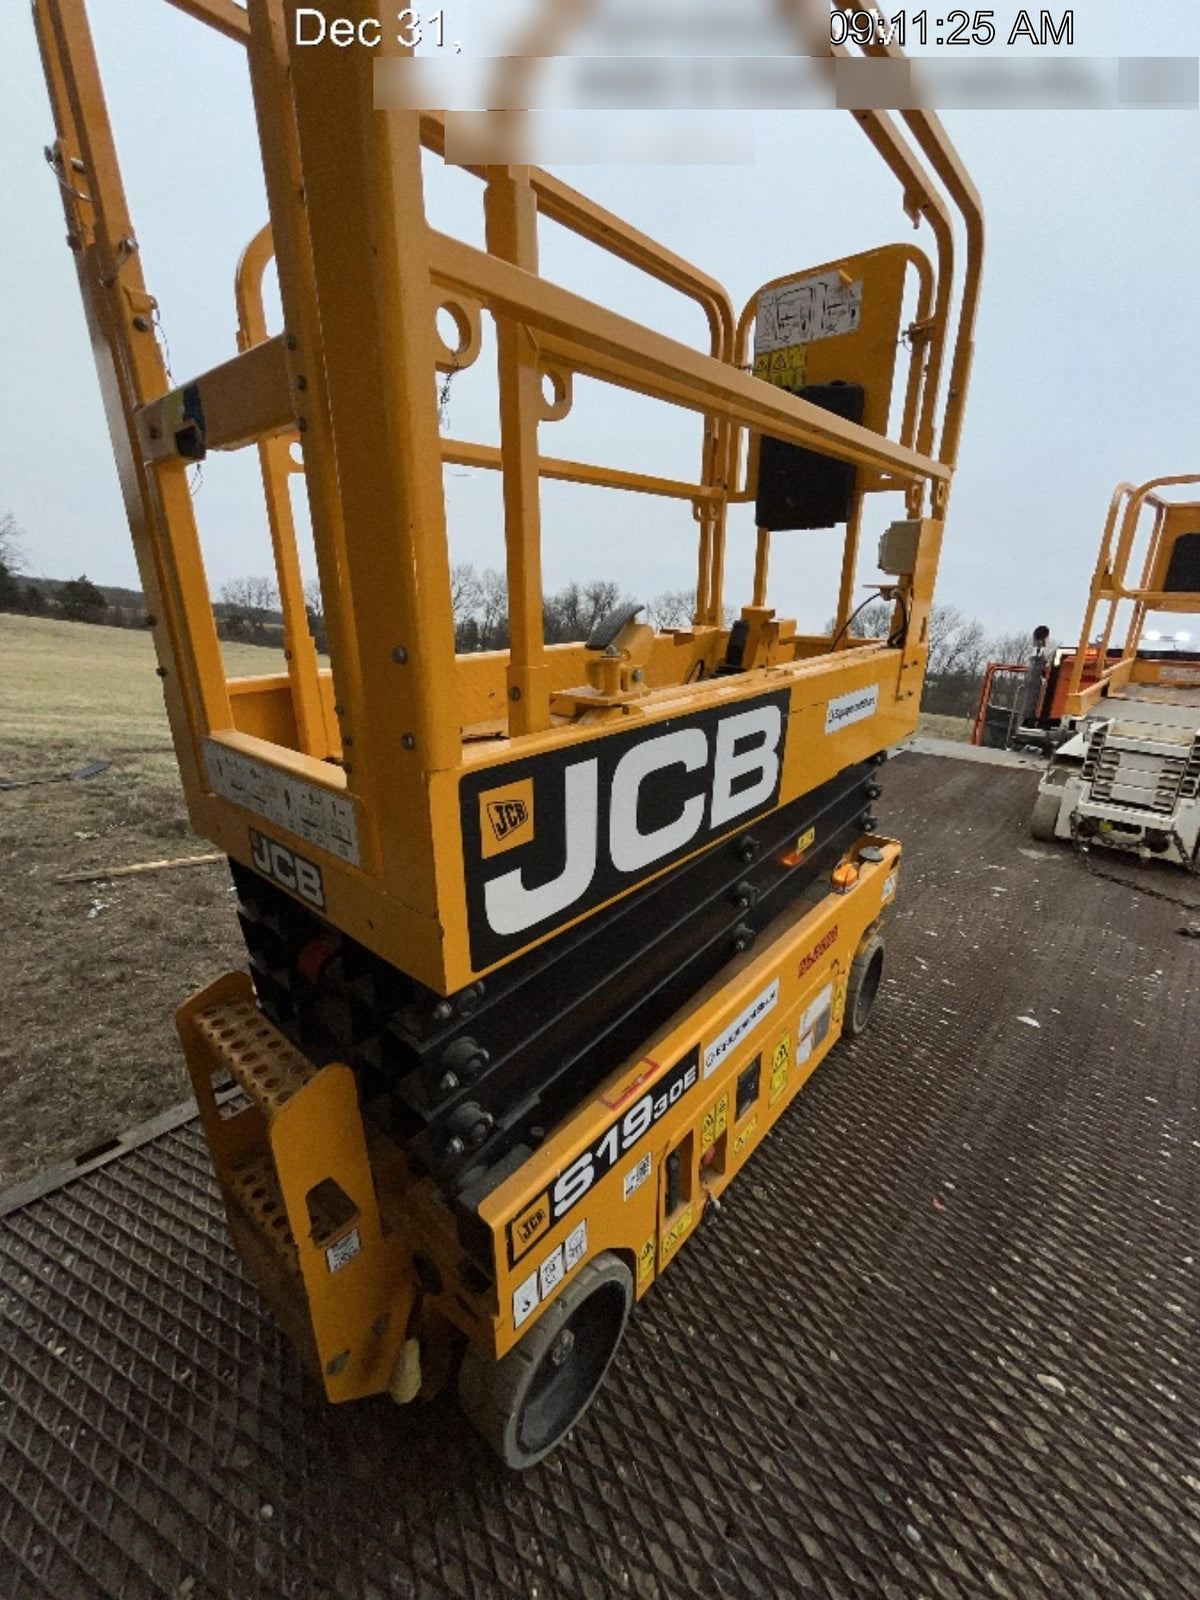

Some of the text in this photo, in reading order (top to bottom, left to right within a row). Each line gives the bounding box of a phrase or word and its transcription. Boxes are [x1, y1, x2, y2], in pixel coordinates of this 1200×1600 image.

[483, 704, 782, 936] JCB
[491, 801, 527, 838] JCB
[253, 836, 325, 908] JCB
